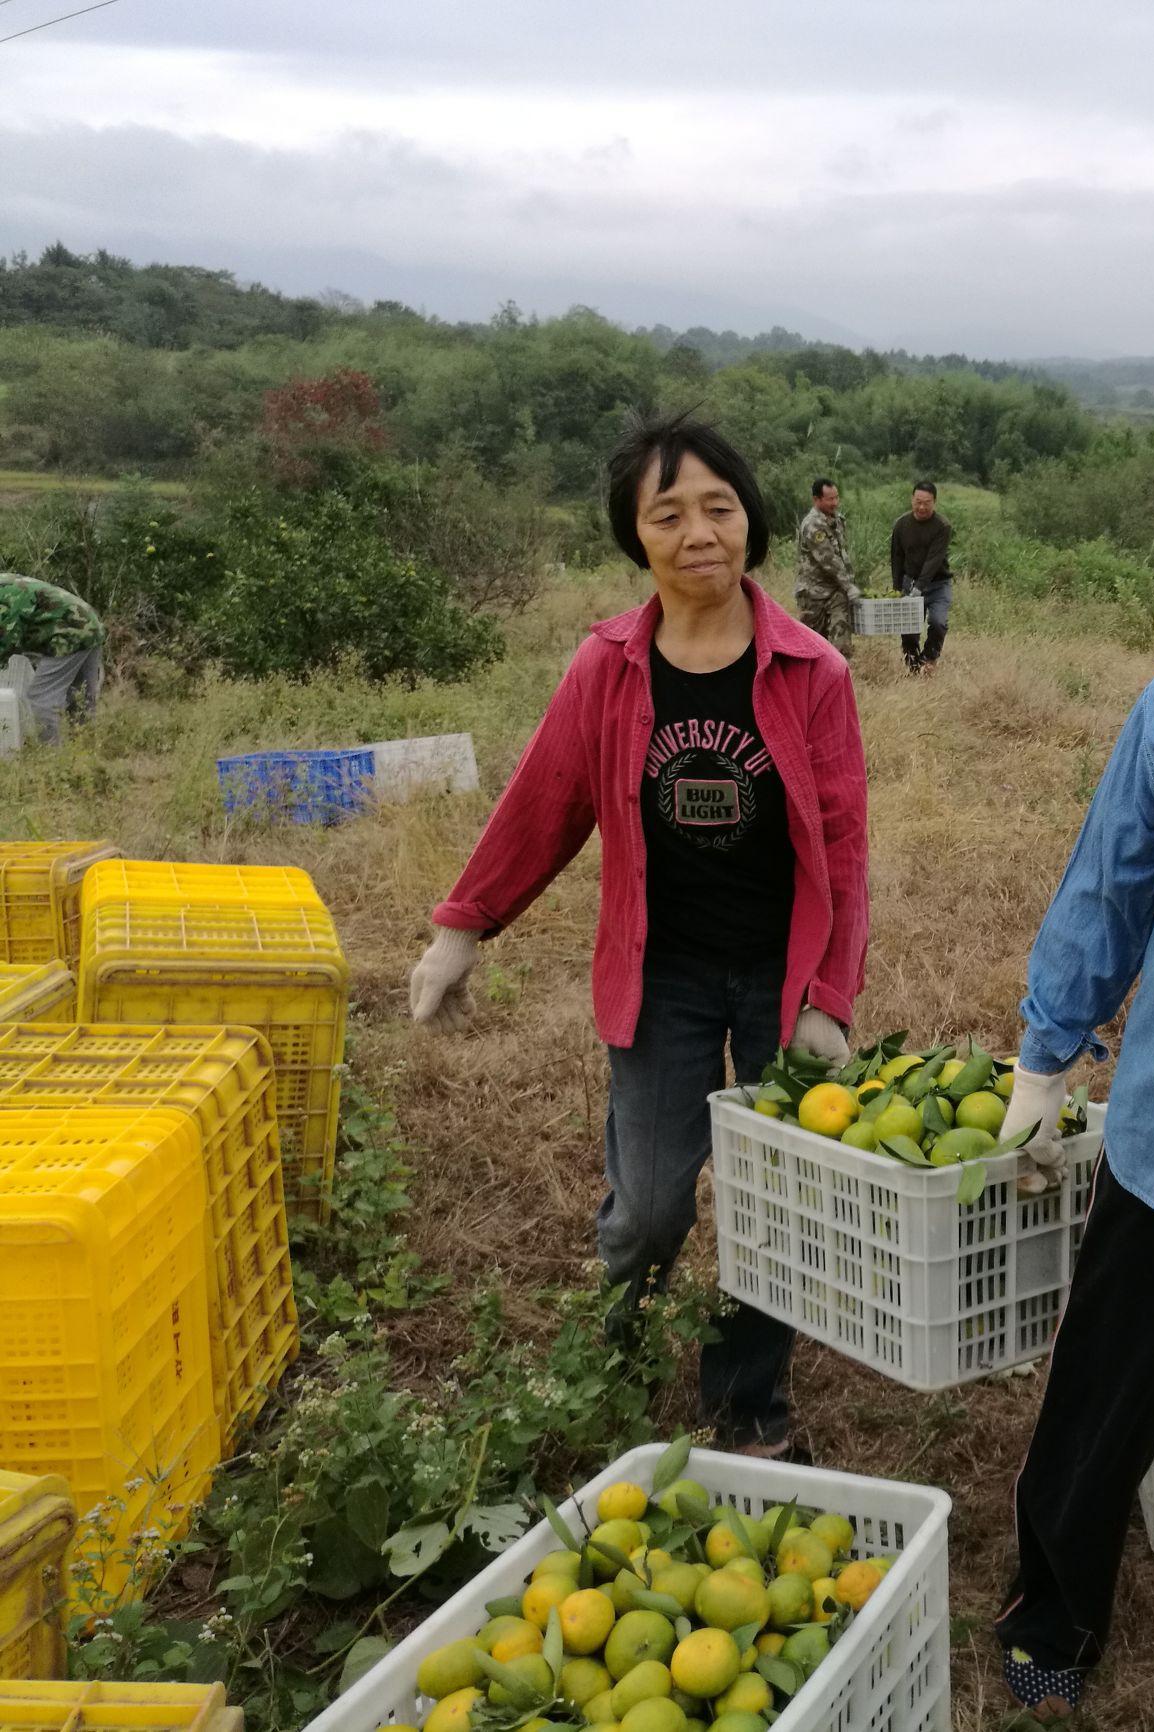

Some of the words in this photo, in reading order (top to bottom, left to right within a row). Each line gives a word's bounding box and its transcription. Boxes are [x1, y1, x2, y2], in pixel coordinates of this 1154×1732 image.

[645, 718, 755, 778] UNIVERSITY
[686, 788, 725, 803] BUD
[681, 805, 734, 819] LIGHT
